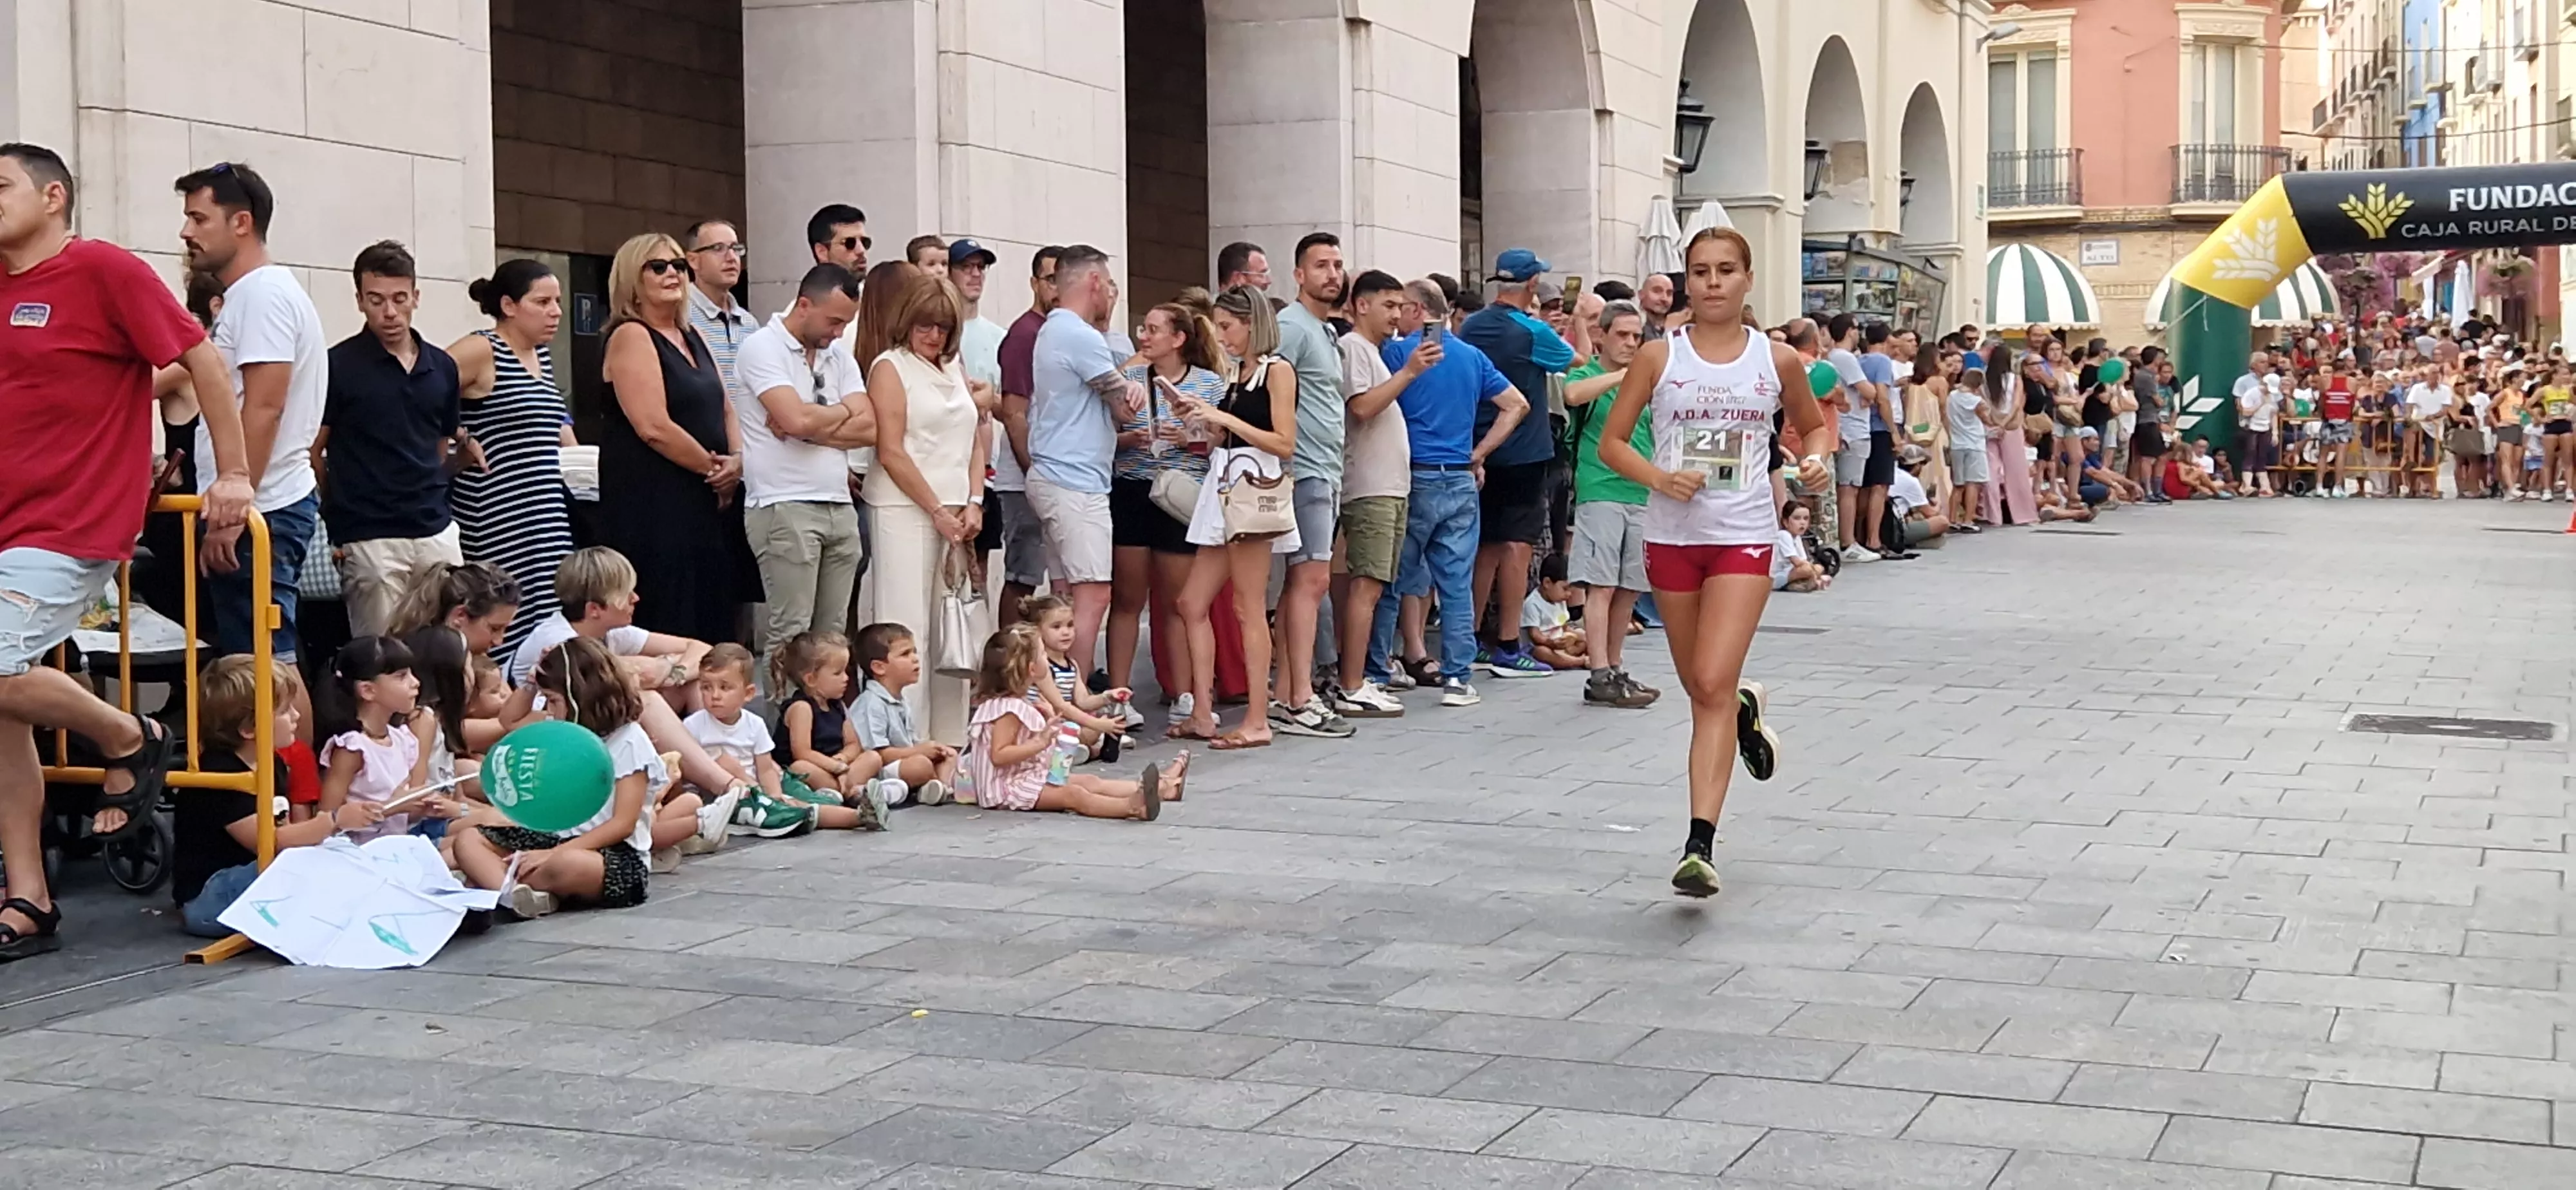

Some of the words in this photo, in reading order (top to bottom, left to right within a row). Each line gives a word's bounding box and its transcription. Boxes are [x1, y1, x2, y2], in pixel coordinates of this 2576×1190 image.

[2448, 182, 2576, 212] FUNDAC
[2401, 222, 2461, 238] CAJA
[2468, 218, 2544, 234] RURAL
[1698, 385, 1732, 394] FUNDA
[1672, 409, 1715, 420] A.D.A.
[1721, 409, 1765, 421] ZUERA
[1695, 430, 1727, 451] 21
[517, 747, 539, 801] FIESTA
